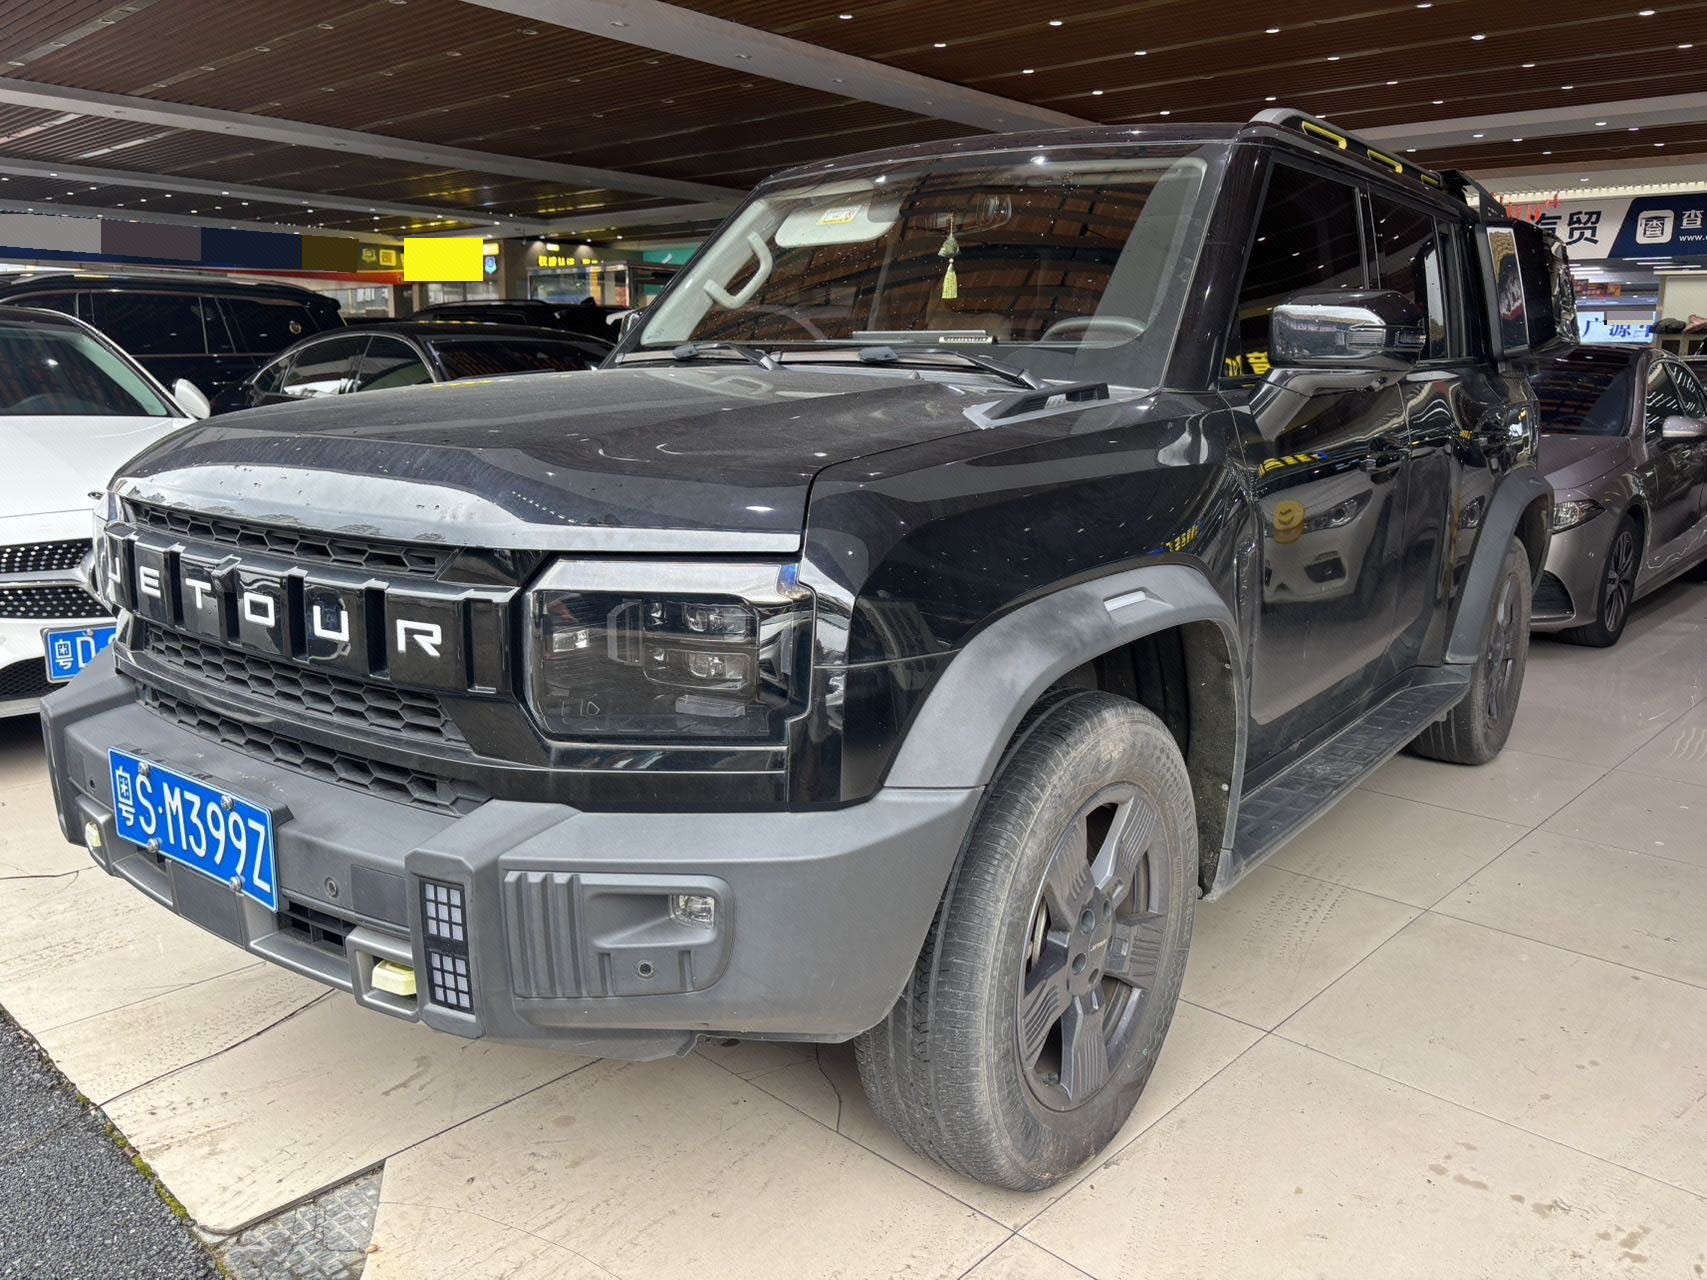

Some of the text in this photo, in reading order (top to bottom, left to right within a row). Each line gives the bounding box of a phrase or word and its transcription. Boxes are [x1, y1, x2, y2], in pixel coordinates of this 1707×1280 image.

[1680, 209, 1705, 229] 查
[108, 557, 442, 657] JETOUR
[54, 633, 117, 670] 粤D
